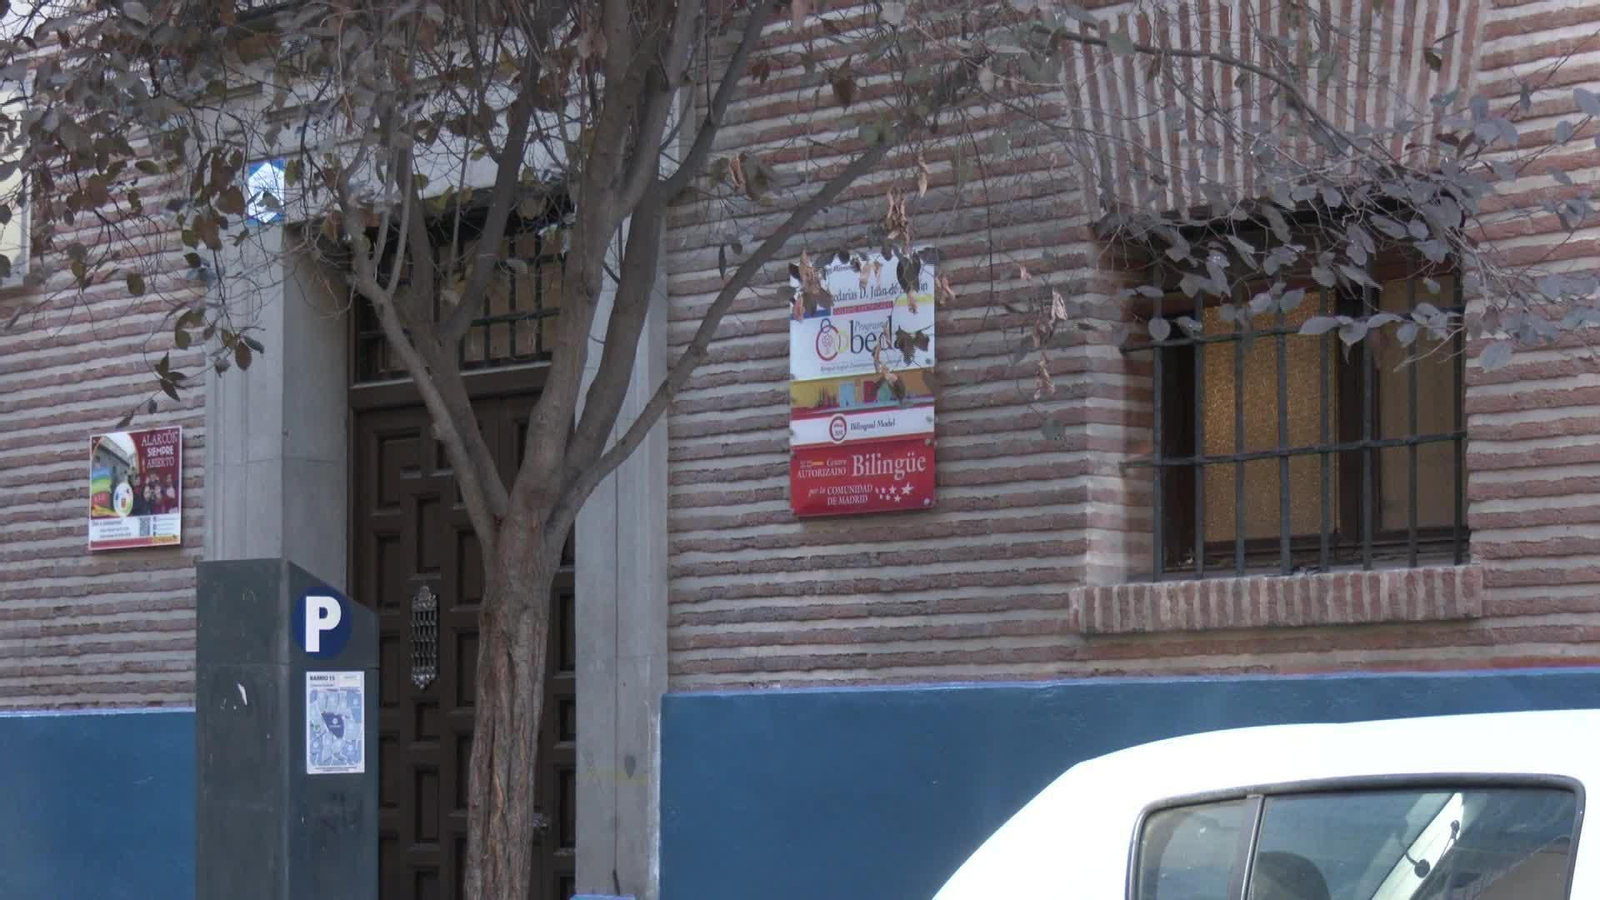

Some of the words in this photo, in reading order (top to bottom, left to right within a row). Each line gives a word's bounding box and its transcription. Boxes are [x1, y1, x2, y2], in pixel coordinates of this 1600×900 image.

[850, 420, 876, 432] Bilingual
[877, 417, 896, 428] Model
[141, 429, 178, 447] ALARCÓN
[147, 445, 174, 457] SIEMPRE
[147, 456, 175, 468] ABIERTO
[826, 459, 847, 467] Centro
[852, 452, 927, 481] Bilingüe
[797, 467, 847, 479] AUTORIZADO
[809, 488, 817, 498] por
[820, 486, 826, 494] la
[827, 484, 873, 495] COMUNIDAD
[827, 496, 838, 506] DE
[838, 494, 868, 505] MADRID
[305, 595, 342, 653] P
